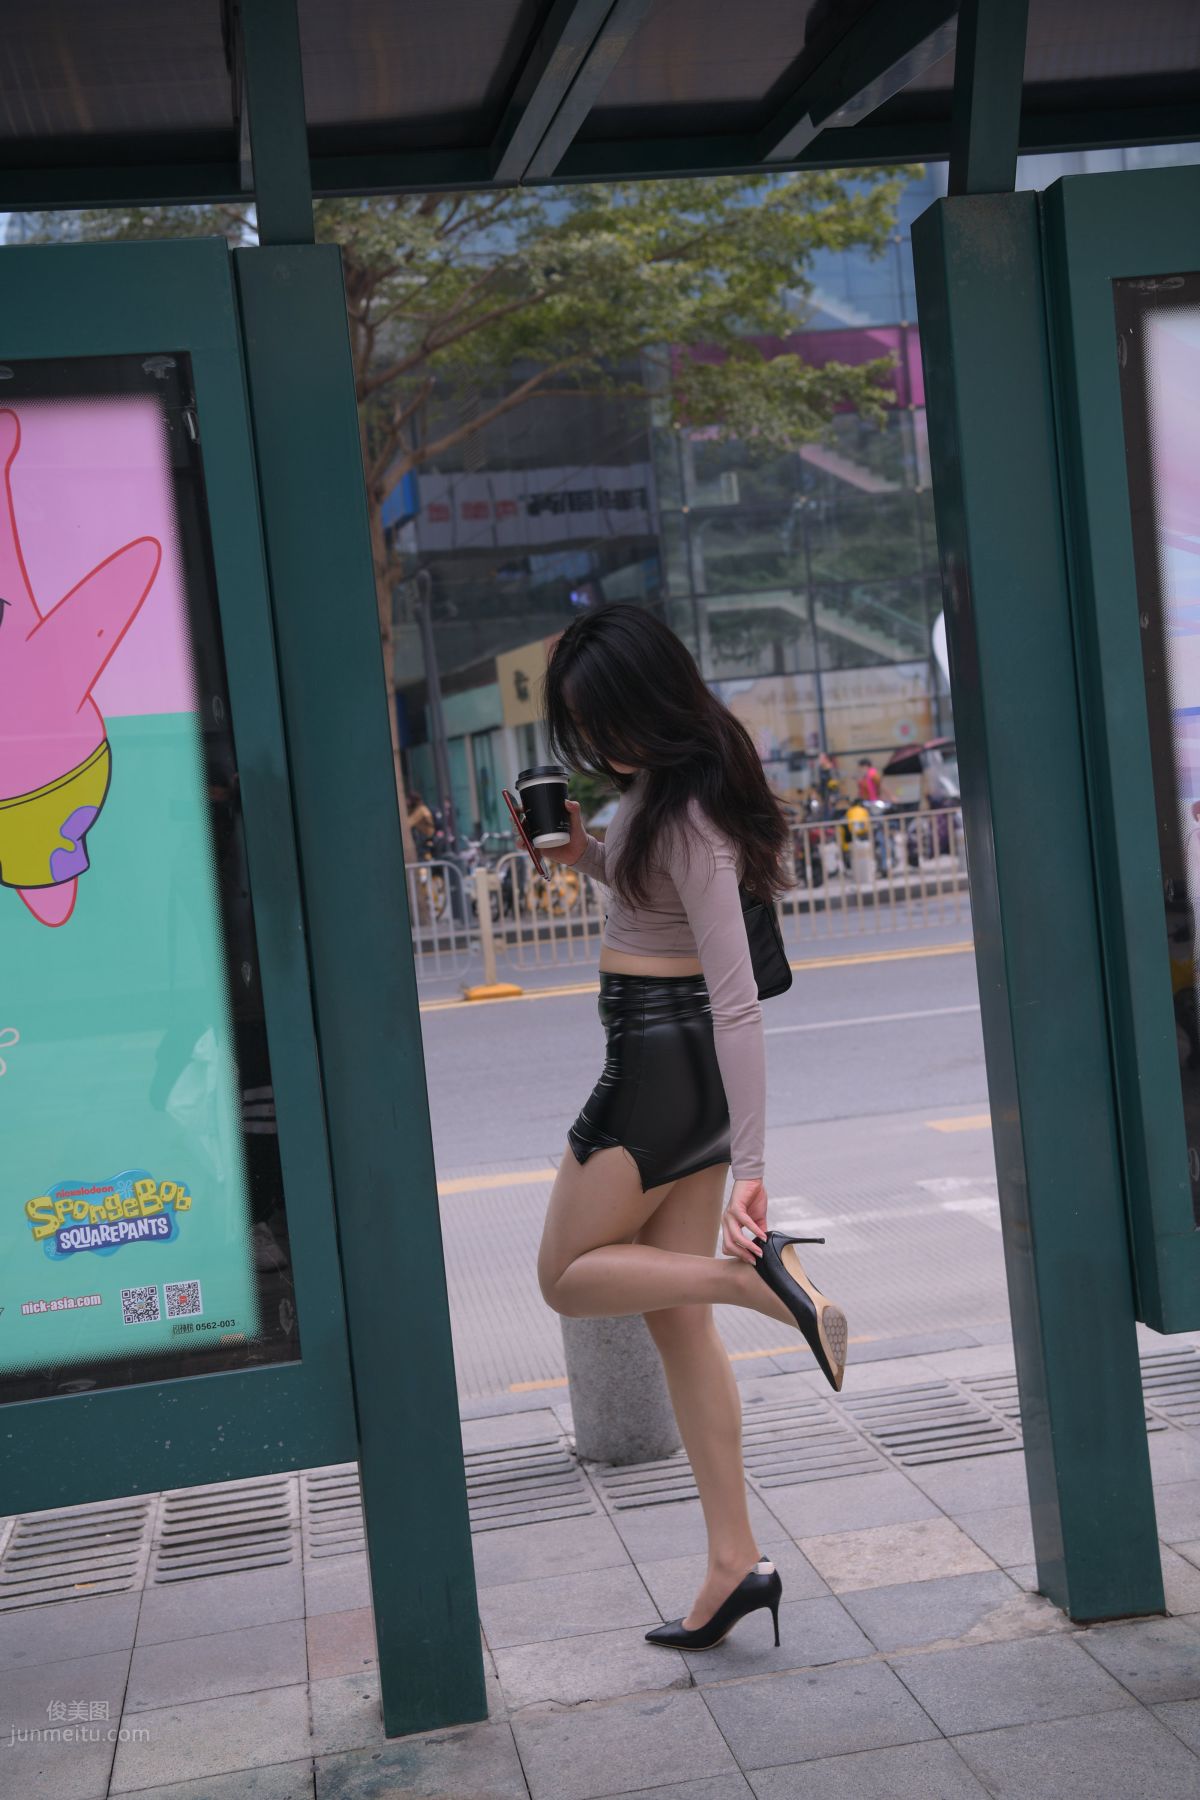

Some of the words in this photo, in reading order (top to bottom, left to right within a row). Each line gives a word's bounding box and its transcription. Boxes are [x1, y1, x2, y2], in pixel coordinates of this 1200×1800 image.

[25, 1179, 192, 1241] SpongeBob
[59, 1217, 169, 1249] SQUAREPANTS
[21, 1294, 102, 1316] nick-asia.com
[195, 1319, 236, 1331] 0562-003
